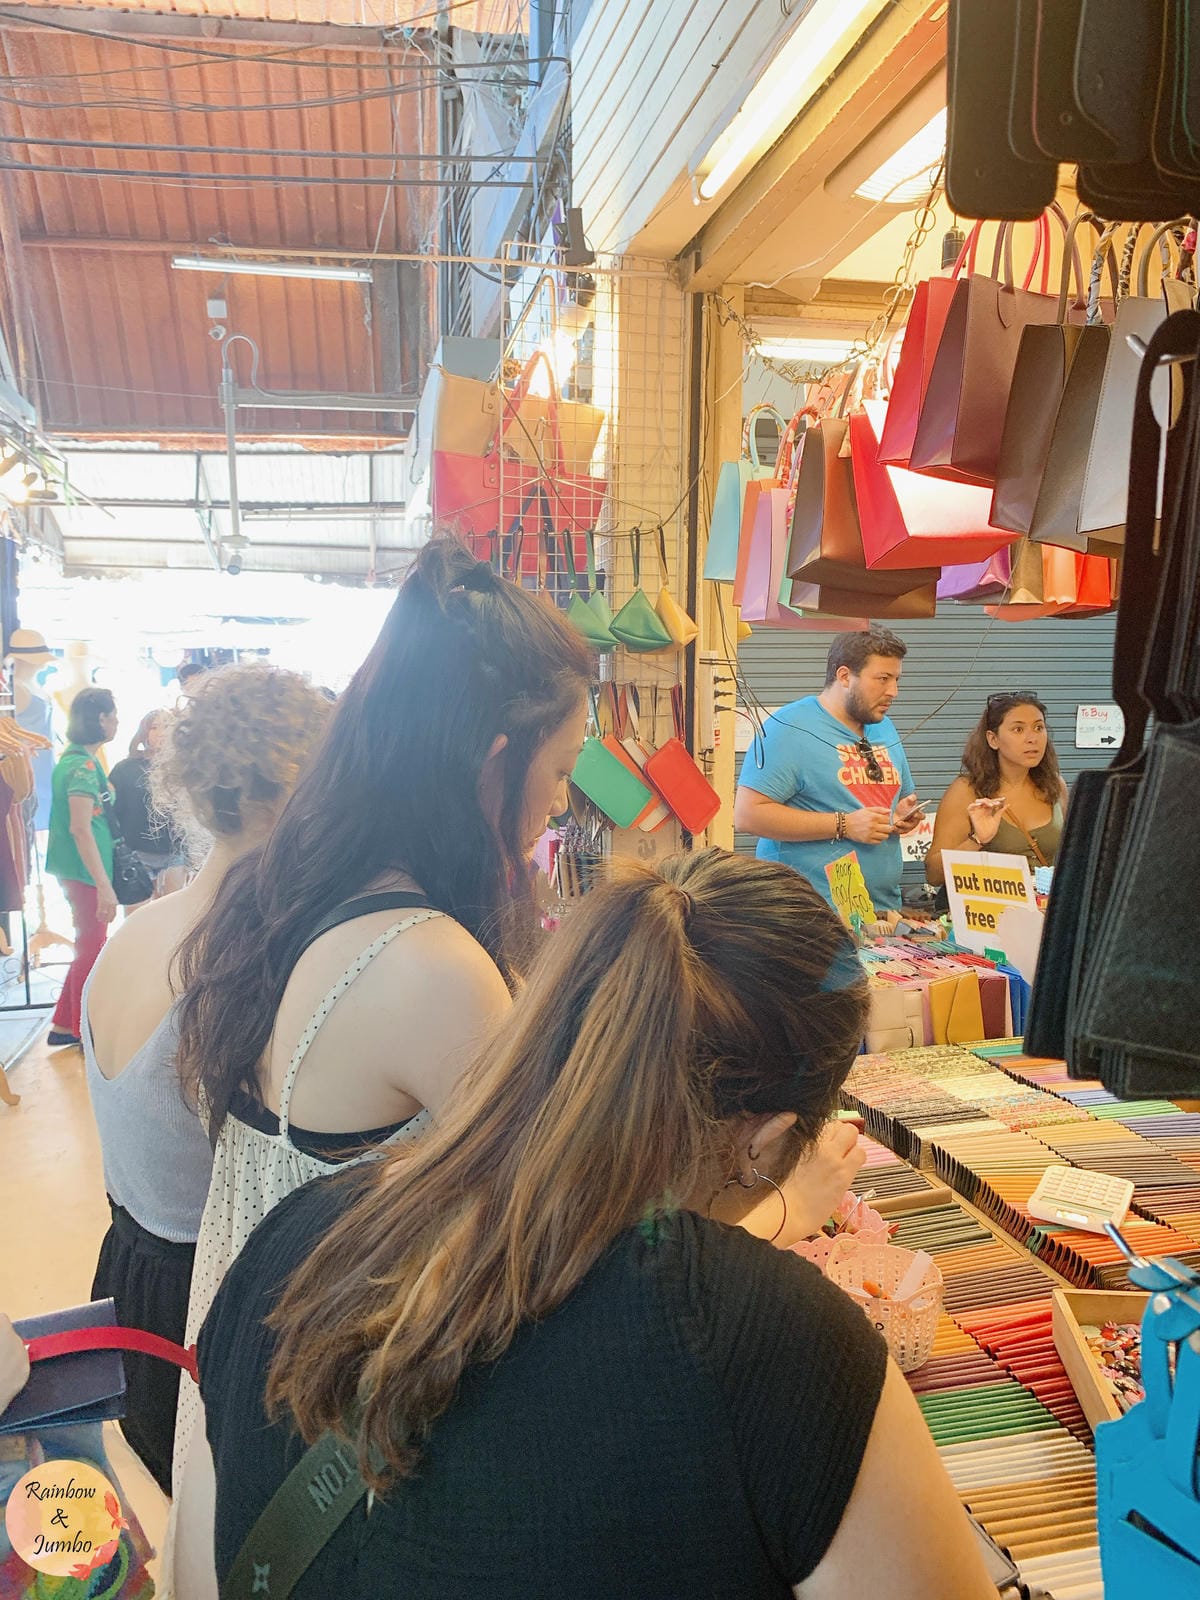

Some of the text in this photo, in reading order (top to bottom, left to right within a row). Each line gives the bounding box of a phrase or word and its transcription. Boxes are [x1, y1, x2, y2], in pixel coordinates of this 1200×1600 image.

[1081, 706, 1109, 722] To Buy
[836, 744, 891, 763] SUER
[837, 766, 901, 786] CHIER
[953, 873, 1027, 897] put name
[965, 905, 996, 929] free
